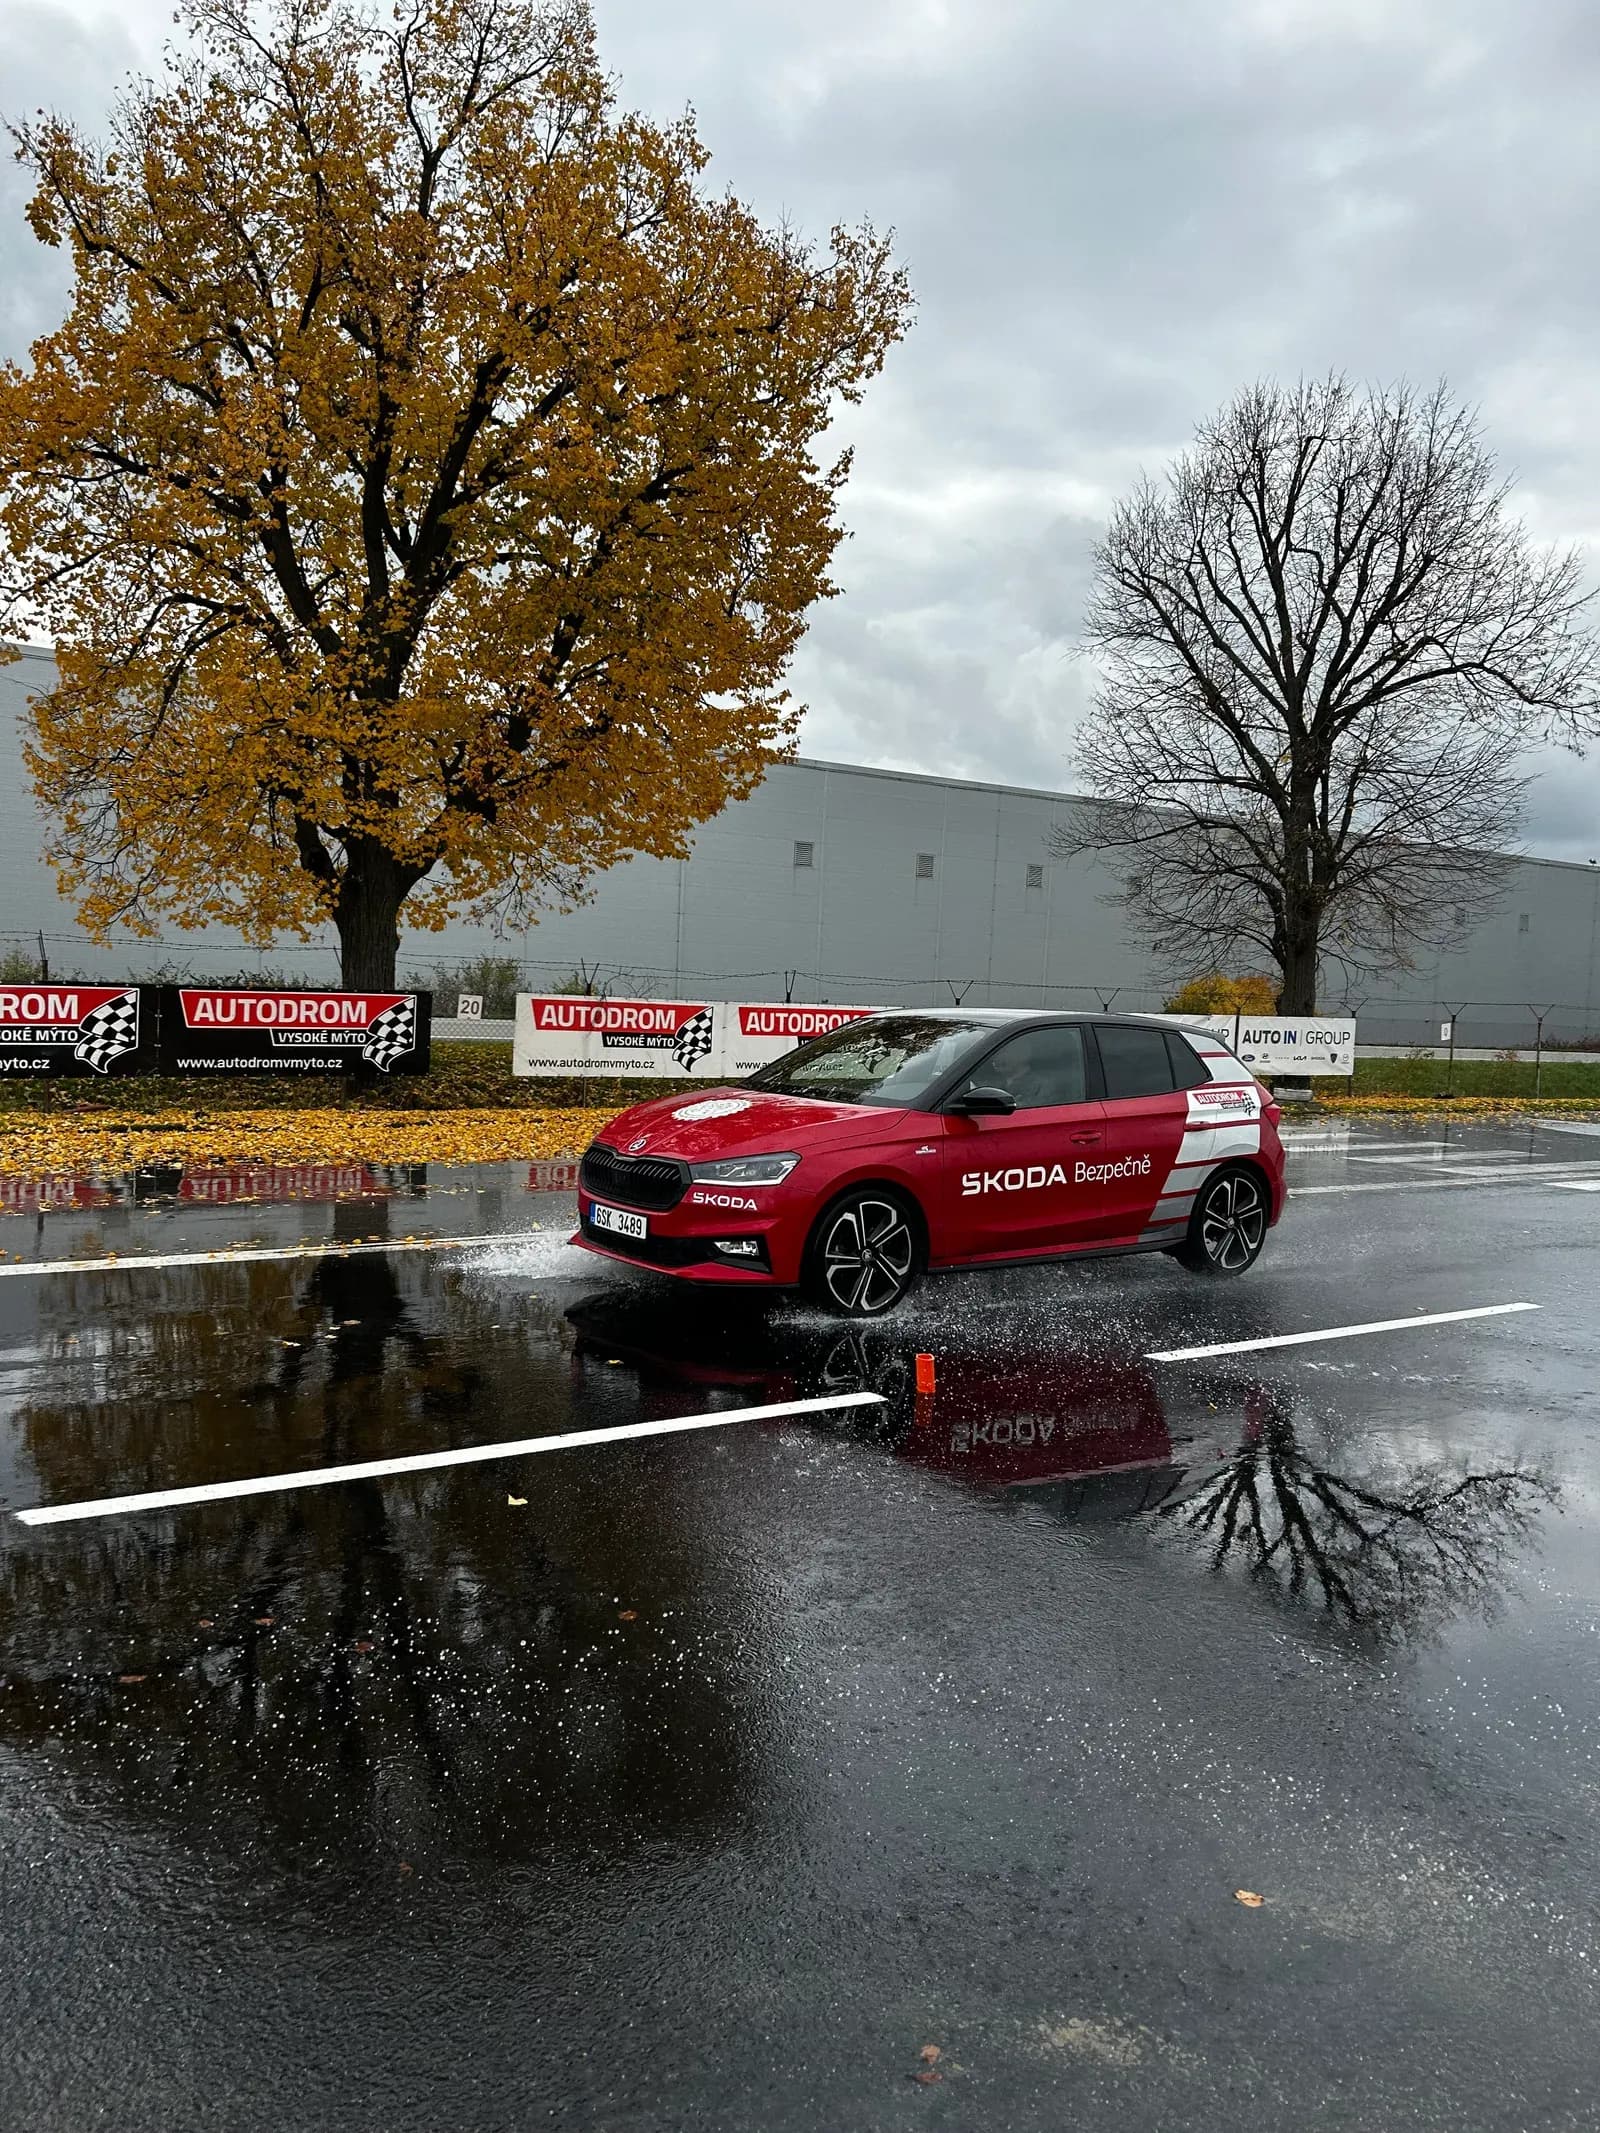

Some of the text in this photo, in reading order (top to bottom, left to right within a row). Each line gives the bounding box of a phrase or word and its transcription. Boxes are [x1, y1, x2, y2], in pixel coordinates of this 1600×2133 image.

[0, 993, 79, 1020] ROM
[192, 997, 367, 1024] AUTODROM
[460, 1000, 480, 1015] 20
[540, 1004, 676, 1031] AUTODROM
[0, 1026, 79, 1042] OKÉ MÝTO
[278, 1030, 367, 1044] VYSOKÉ MÝTO
[606, 1034, 675, 1048] VYSOKÉ MÝTO
[1242, 1029, 1281, 1045] AUTO
[1283, 1030, 1298, 1045] IN
[1305, 1030, 1351, 1046] GROUP
[176, 1057, 343, 1071] www.autodromvmyto.cz
[528, 1057, 655, 1071] www.autodromvmyto.cz
[1074, 1154, 1152, 1185] Bezpečně
[596, 1207, 642, 1236] 6SK 3489
